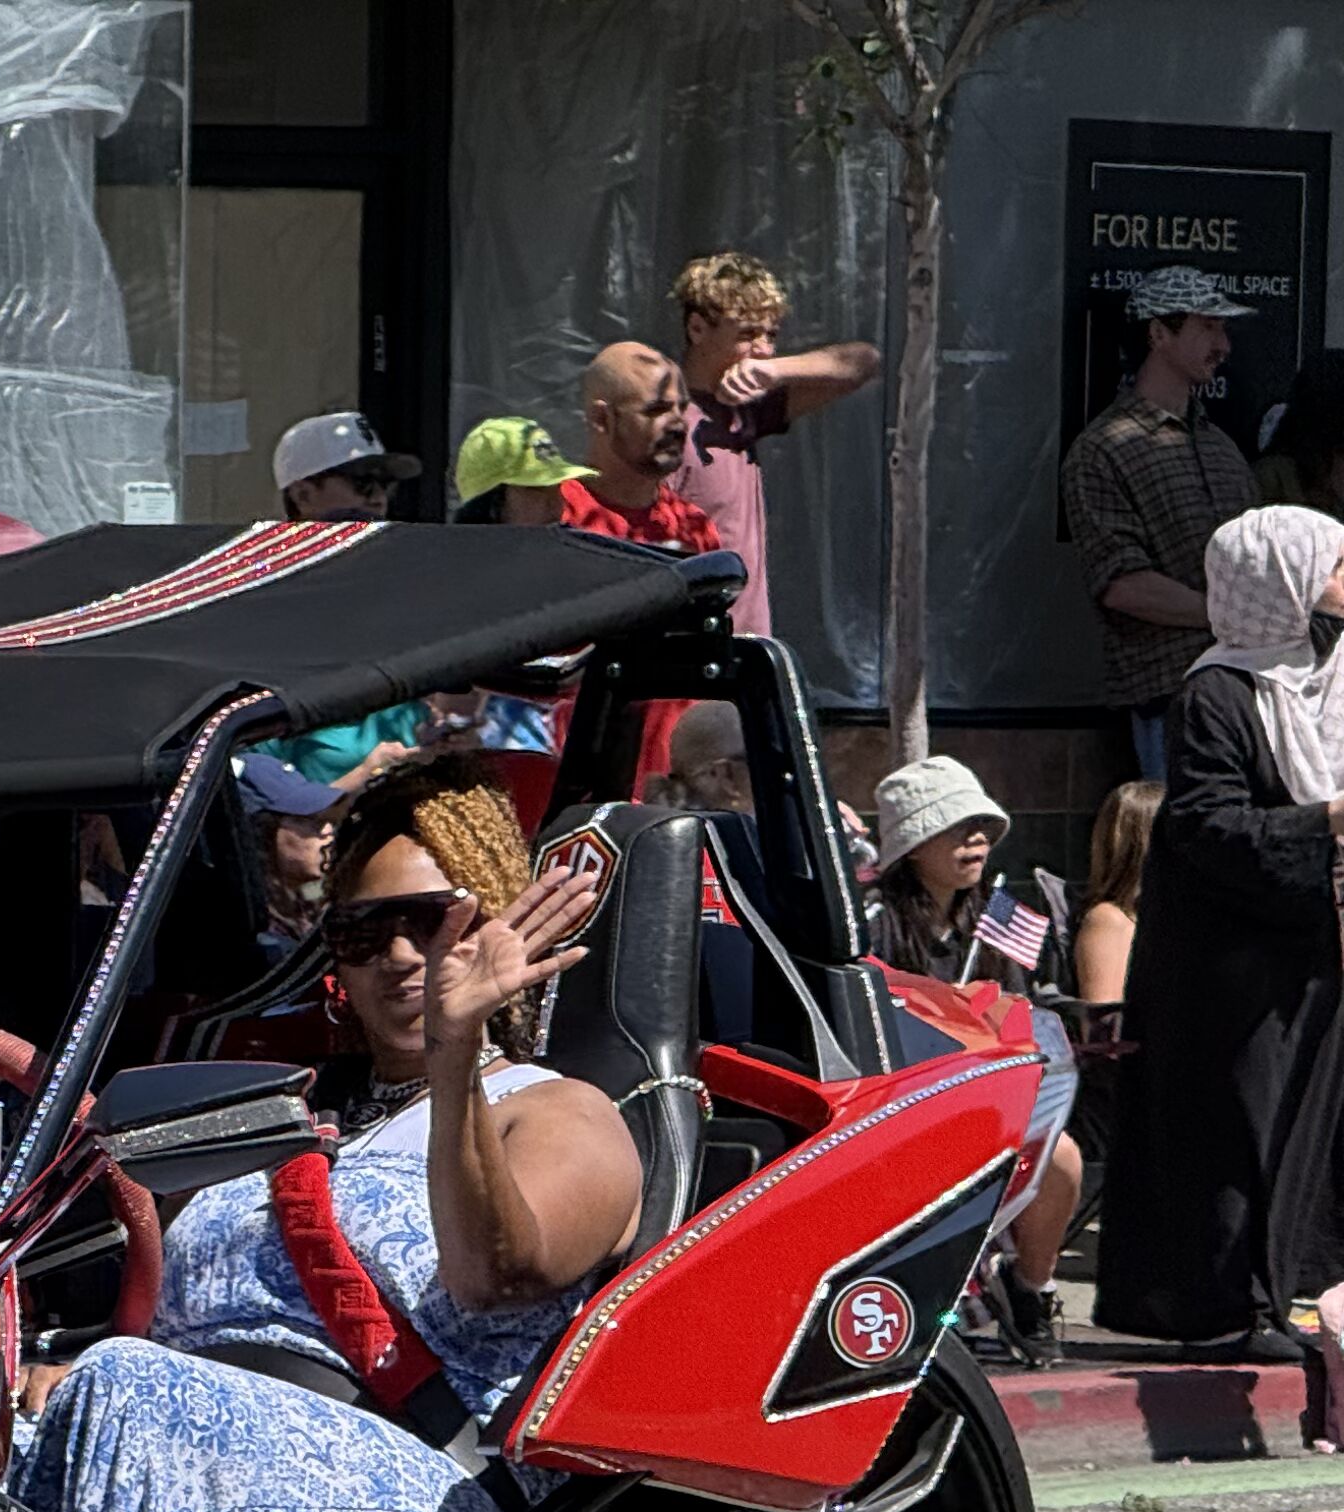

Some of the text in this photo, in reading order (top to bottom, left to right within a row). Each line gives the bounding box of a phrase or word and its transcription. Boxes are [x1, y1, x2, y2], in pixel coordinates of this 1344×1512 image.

[1092, 213, 1239, 252] FOR LEASE
[1244, 275, 1291, 296] SPACE
[851, 1291, 899, 1355] SF
